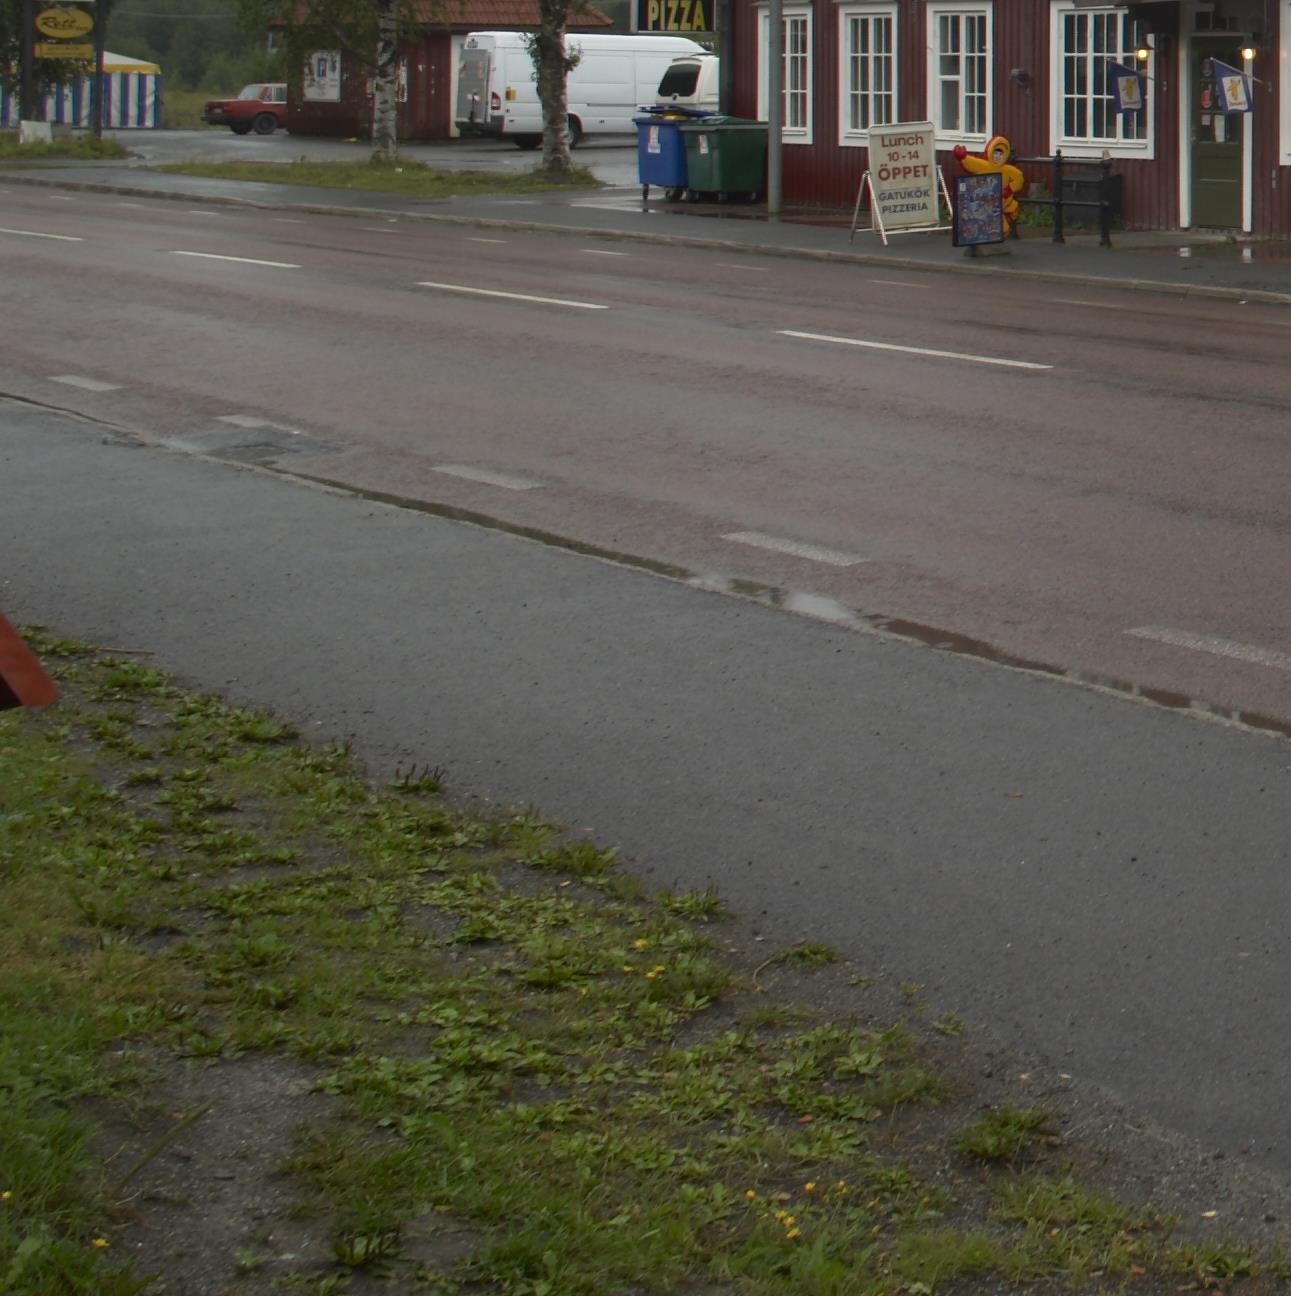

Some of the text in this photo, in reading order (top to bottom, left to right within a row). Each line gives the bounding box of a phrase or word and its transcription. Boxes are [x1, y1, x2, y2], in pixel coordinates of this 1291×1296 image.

[647, 0, 706, 32] PIZZA
[881, 134, 924, 148] Lunch
[878, 164, 929, 181] ÖPPET
[878, 188, 930, 202] GATUKÖK
[881, 202, 929, 214] PIZZERIA
